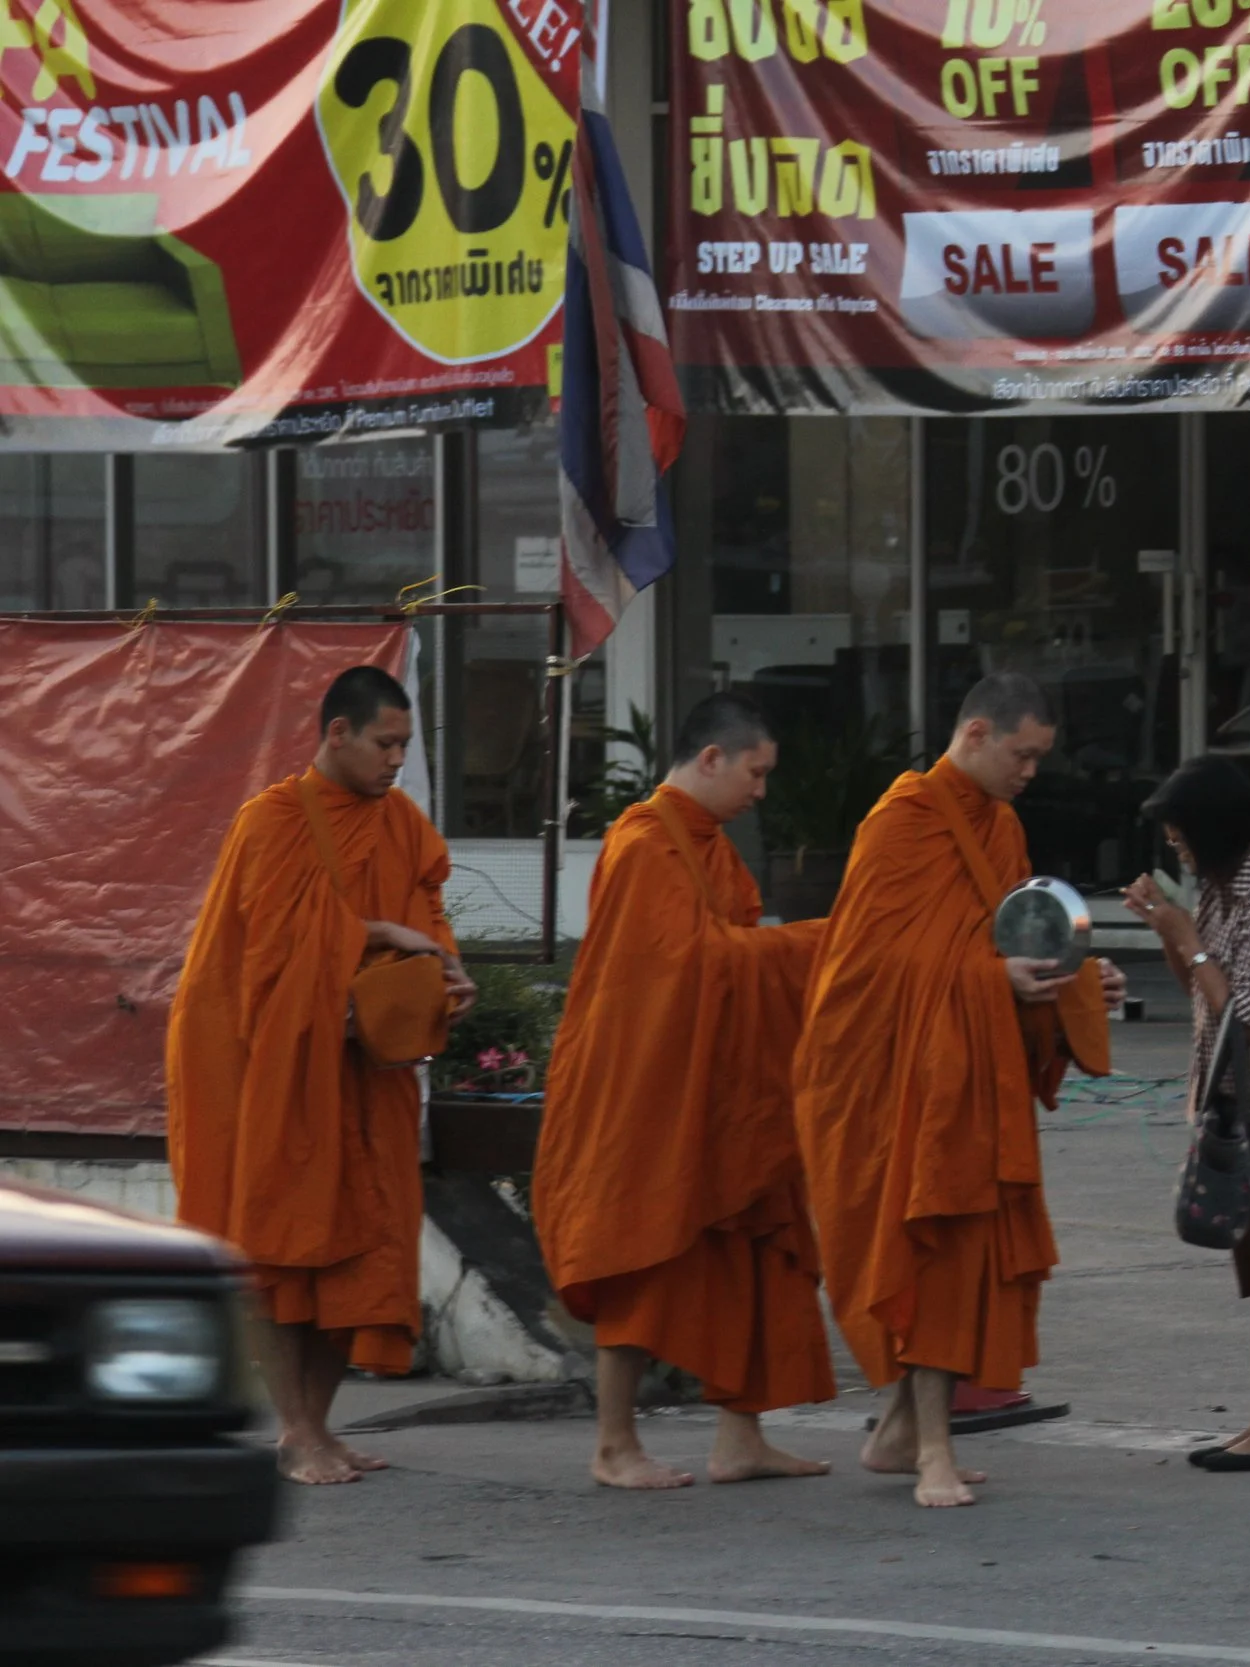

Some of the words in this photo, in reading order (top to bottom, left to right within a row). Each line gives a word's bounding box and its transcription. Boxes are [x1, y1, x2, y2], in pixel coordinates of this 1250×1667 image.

[940, 57, 1040, 120] OFF
[5, 91, 252, 182] FESTIVAL
[334, 22, 571, 242] 30%
[690, 84, 876, 220] ยิ่งลด
[696, 241, 762, 274] STEP
[768, 241, 804, 274] UP
[810, 242, 869, 275] SALE
[943, 242, 1060, 295] SALE
[996, 443, 1117, 515] 80%
